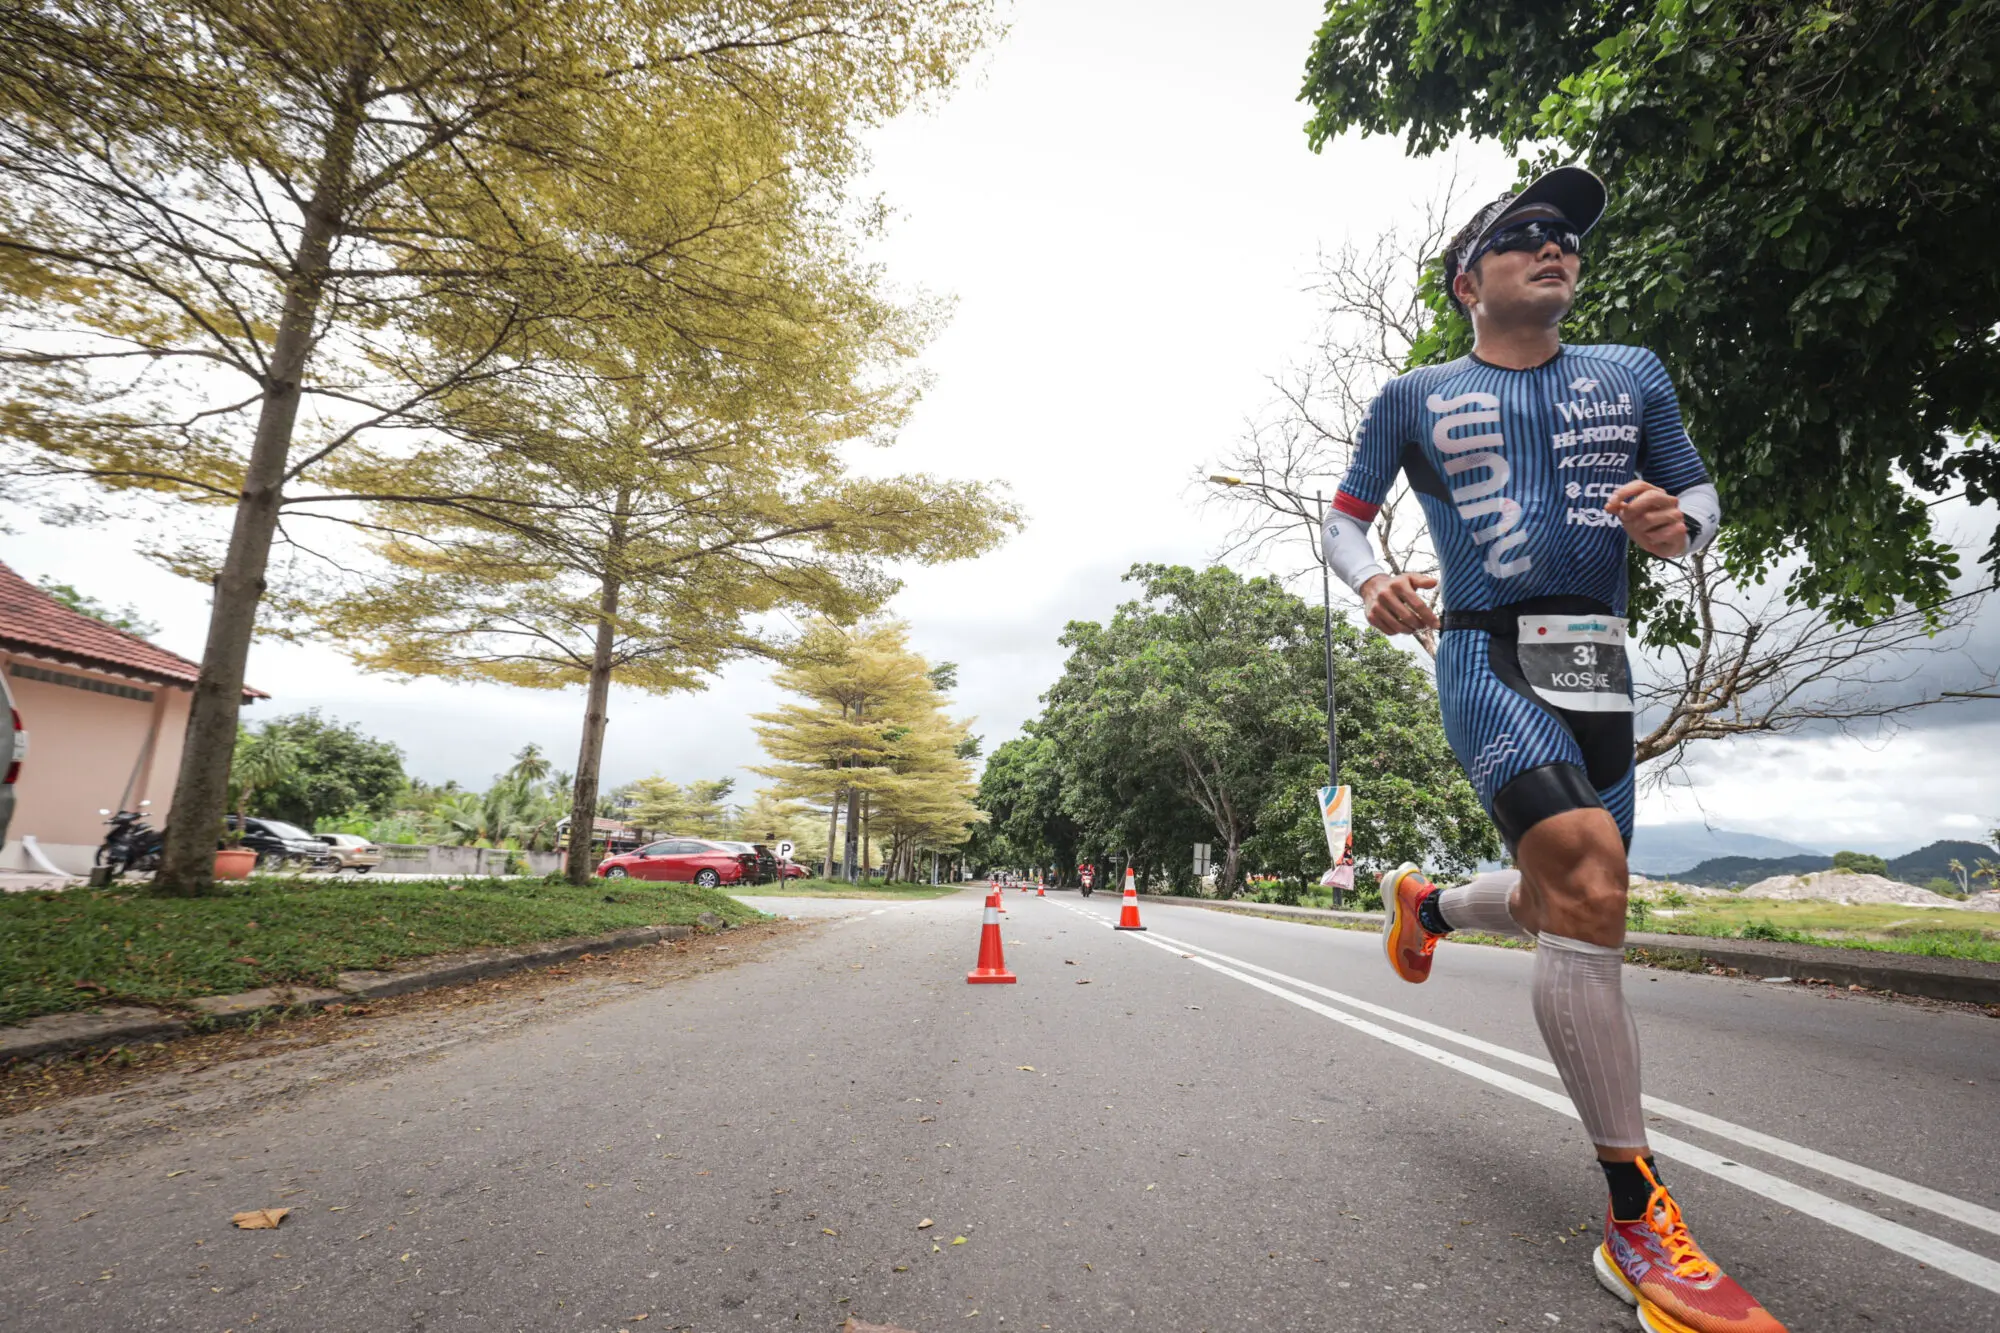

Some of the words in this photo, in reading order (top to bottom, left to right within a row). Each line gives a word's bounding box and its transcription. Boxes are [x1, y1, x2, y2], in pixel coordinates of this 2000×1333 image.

[1556, 399, 1632, 423] Welfare
[1552, 425, 1639, 449] Hi-RIDGE
[1558, 452, 1629, 469] KODA
[781, 843, 791, 856] P
